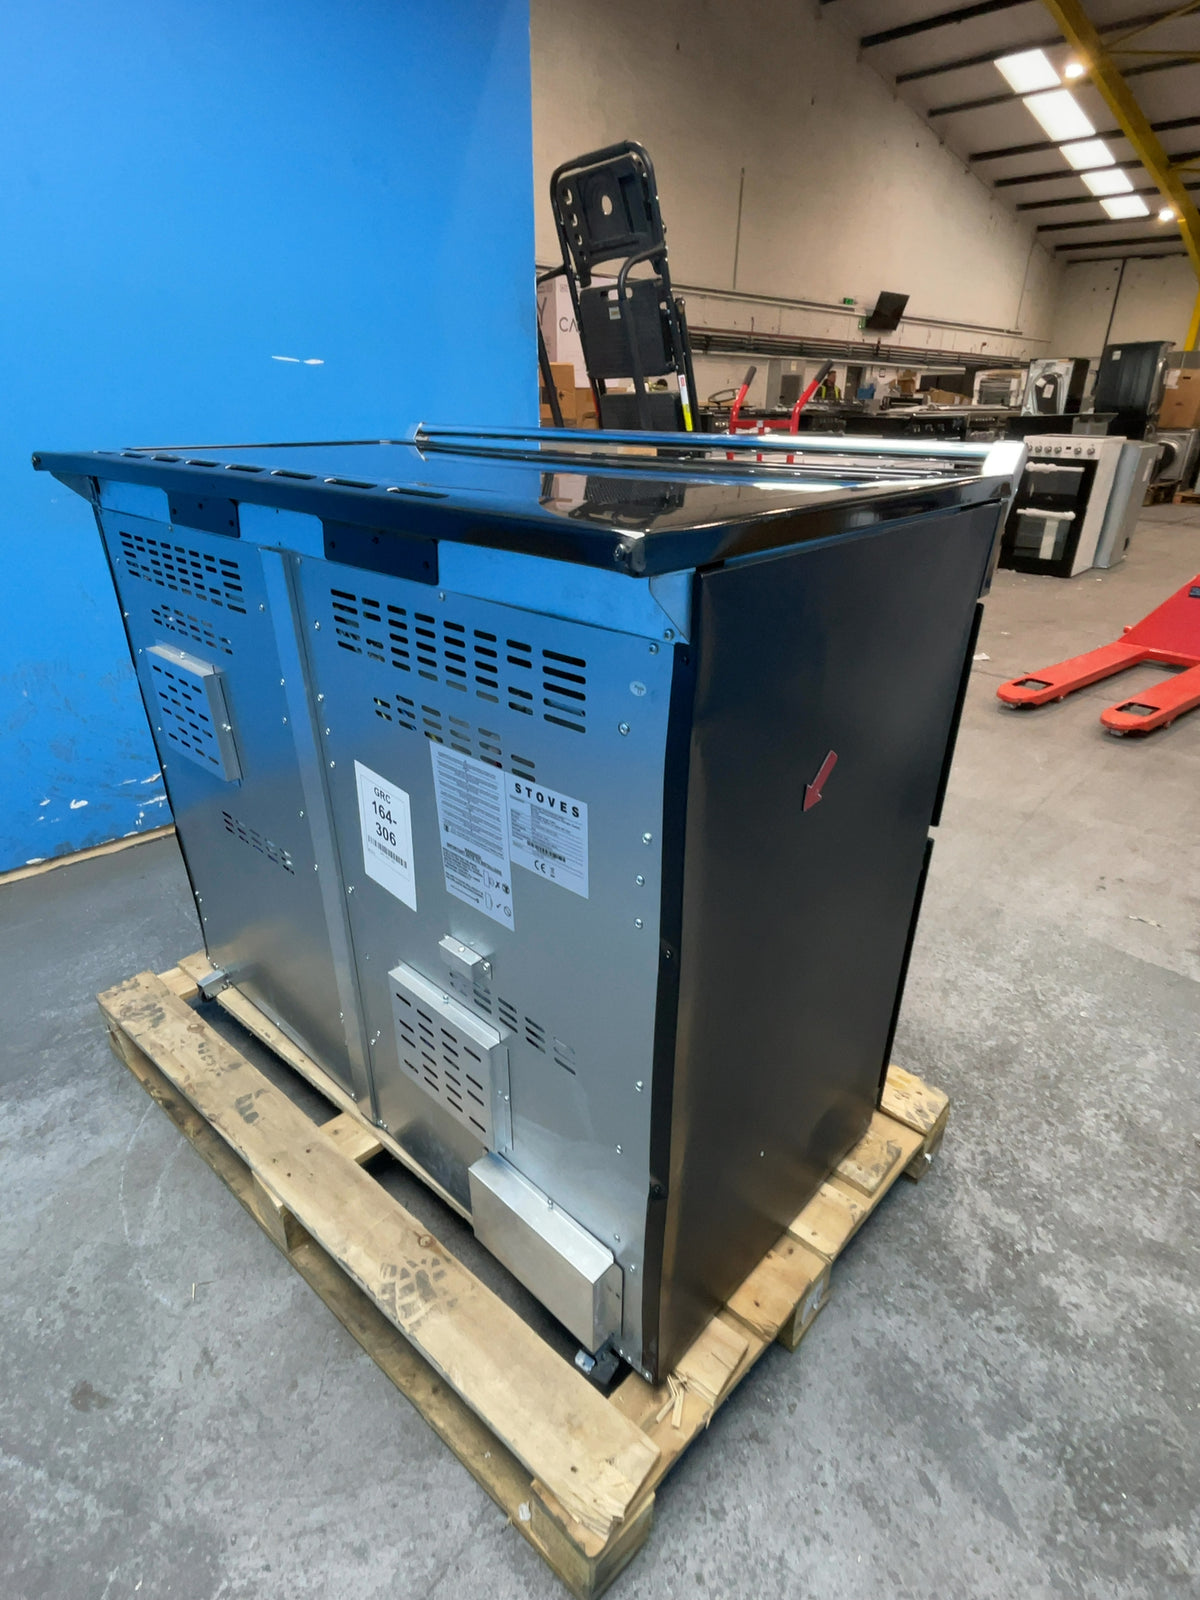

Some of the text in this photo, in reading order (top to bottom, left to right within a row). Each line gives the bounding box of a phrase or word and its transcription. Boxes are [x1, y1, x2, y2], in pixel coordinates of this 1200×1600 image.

[373, 786, 391, 804] GRC
[514, 783, 580, 818] STOVES
[372, 801, 398, 825] 164-
[375, 822, 397, 847] 306
